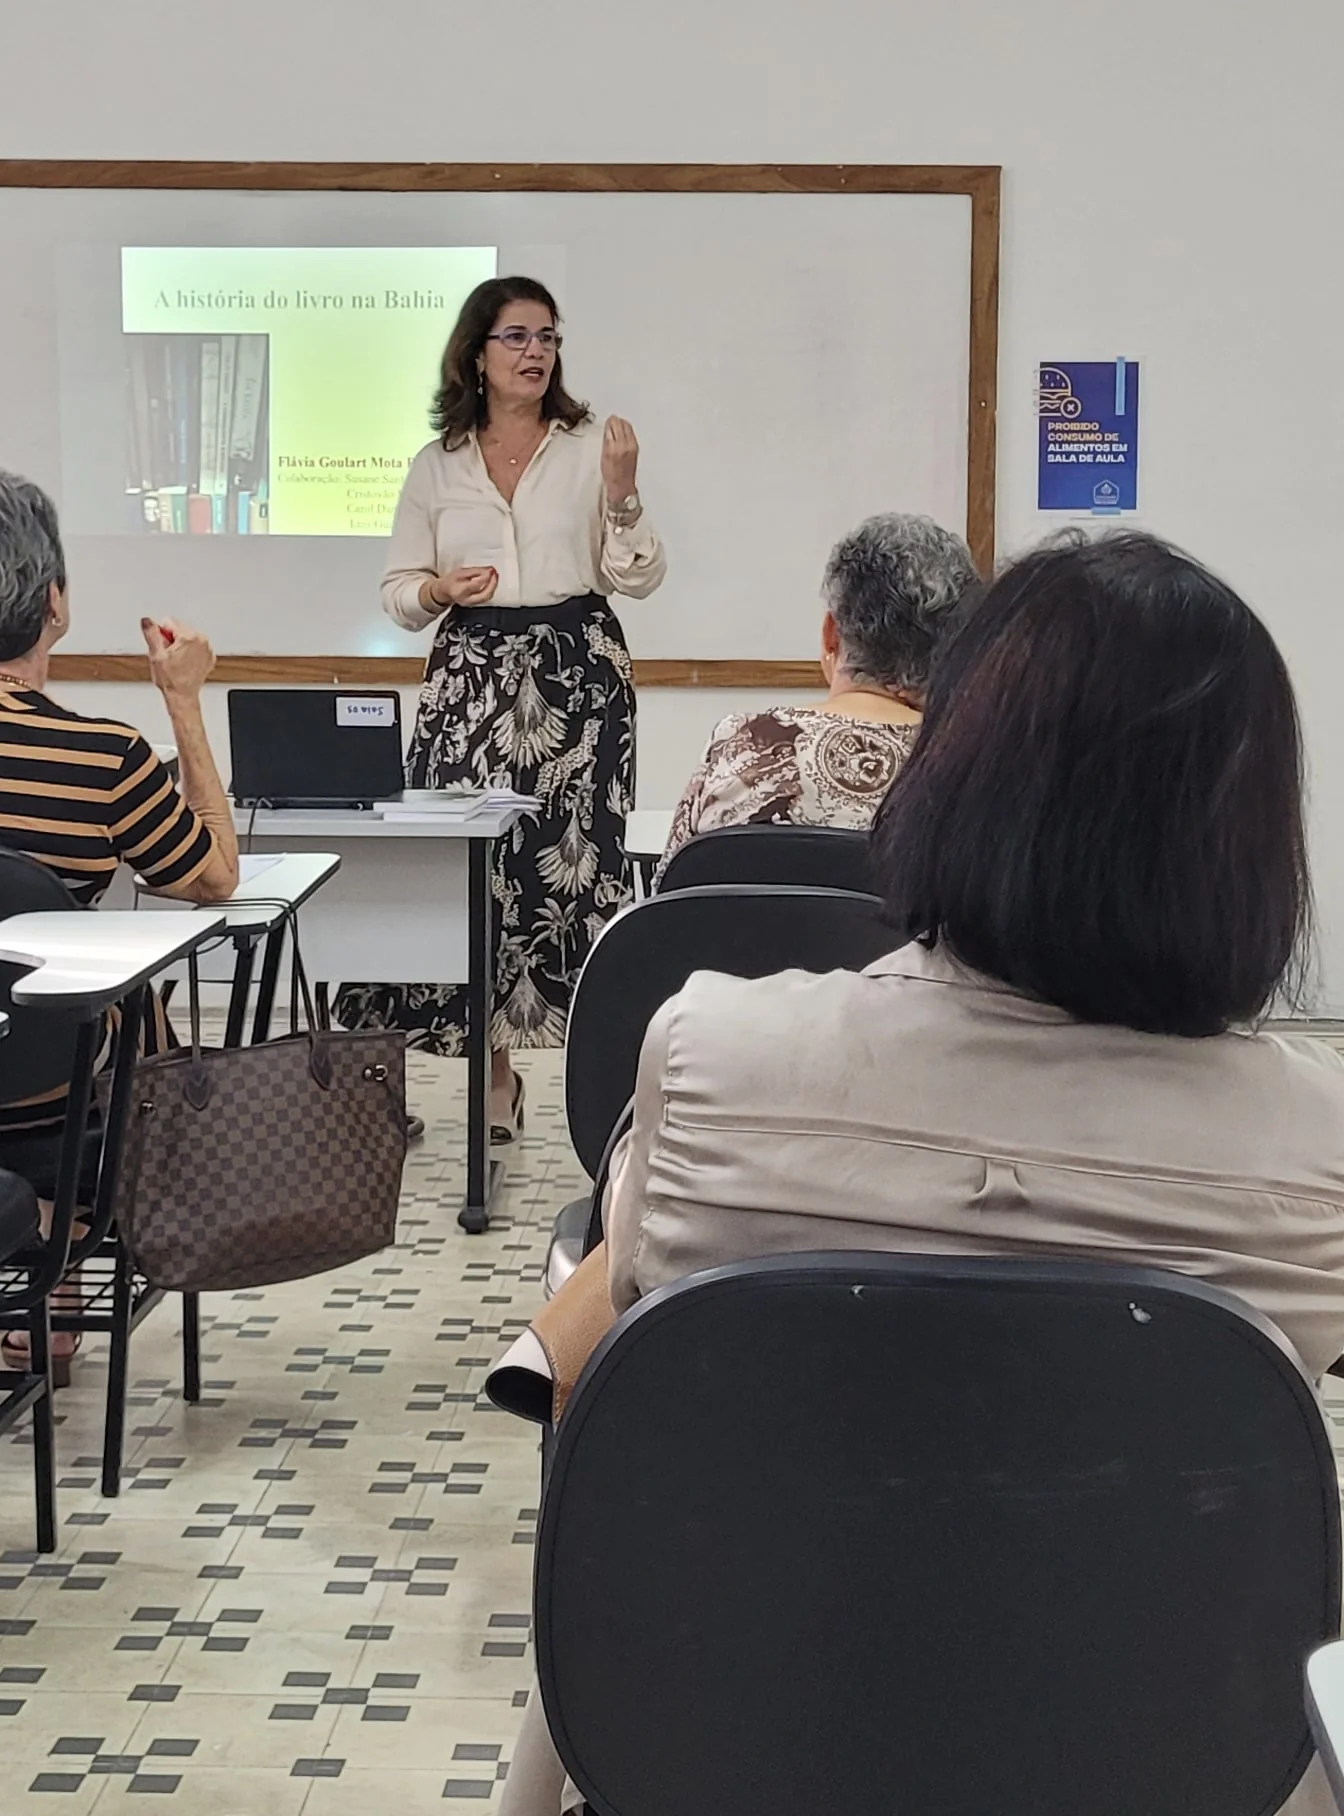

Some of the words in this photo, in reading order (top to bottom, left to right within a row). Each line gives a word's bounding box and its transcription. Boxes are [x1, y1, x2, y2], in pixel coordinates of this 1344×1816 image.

[154, 290, 170, 309] A
[177, 288, 255, 310] história
[264, 289, 288, 310] do
[295, 289, 343, 310] livro
[351, 295, 376, 310] na
[384, 289, 446, 310] Bahia
[1047, 422, 1099, 431] PROIBIDO
[1047, 433, 1103, 442] CONSUMO
[1104, 433, 1119, 442] DE
[1047, 443, 1110, 452] ALIMENTOS
[1111, 443, 1128, 452] EM
[278, 456, 315, 468] Flávia
[319, 456, 367, 468] Goulart
[371, 457, 402, 468] Mota
[1047, 454, 1077, 463] SALA
[1078, 454, 1094, 463] DE
[1096, 454, 1125, 463] AULA
[361, 706, 384, 716] Sala
